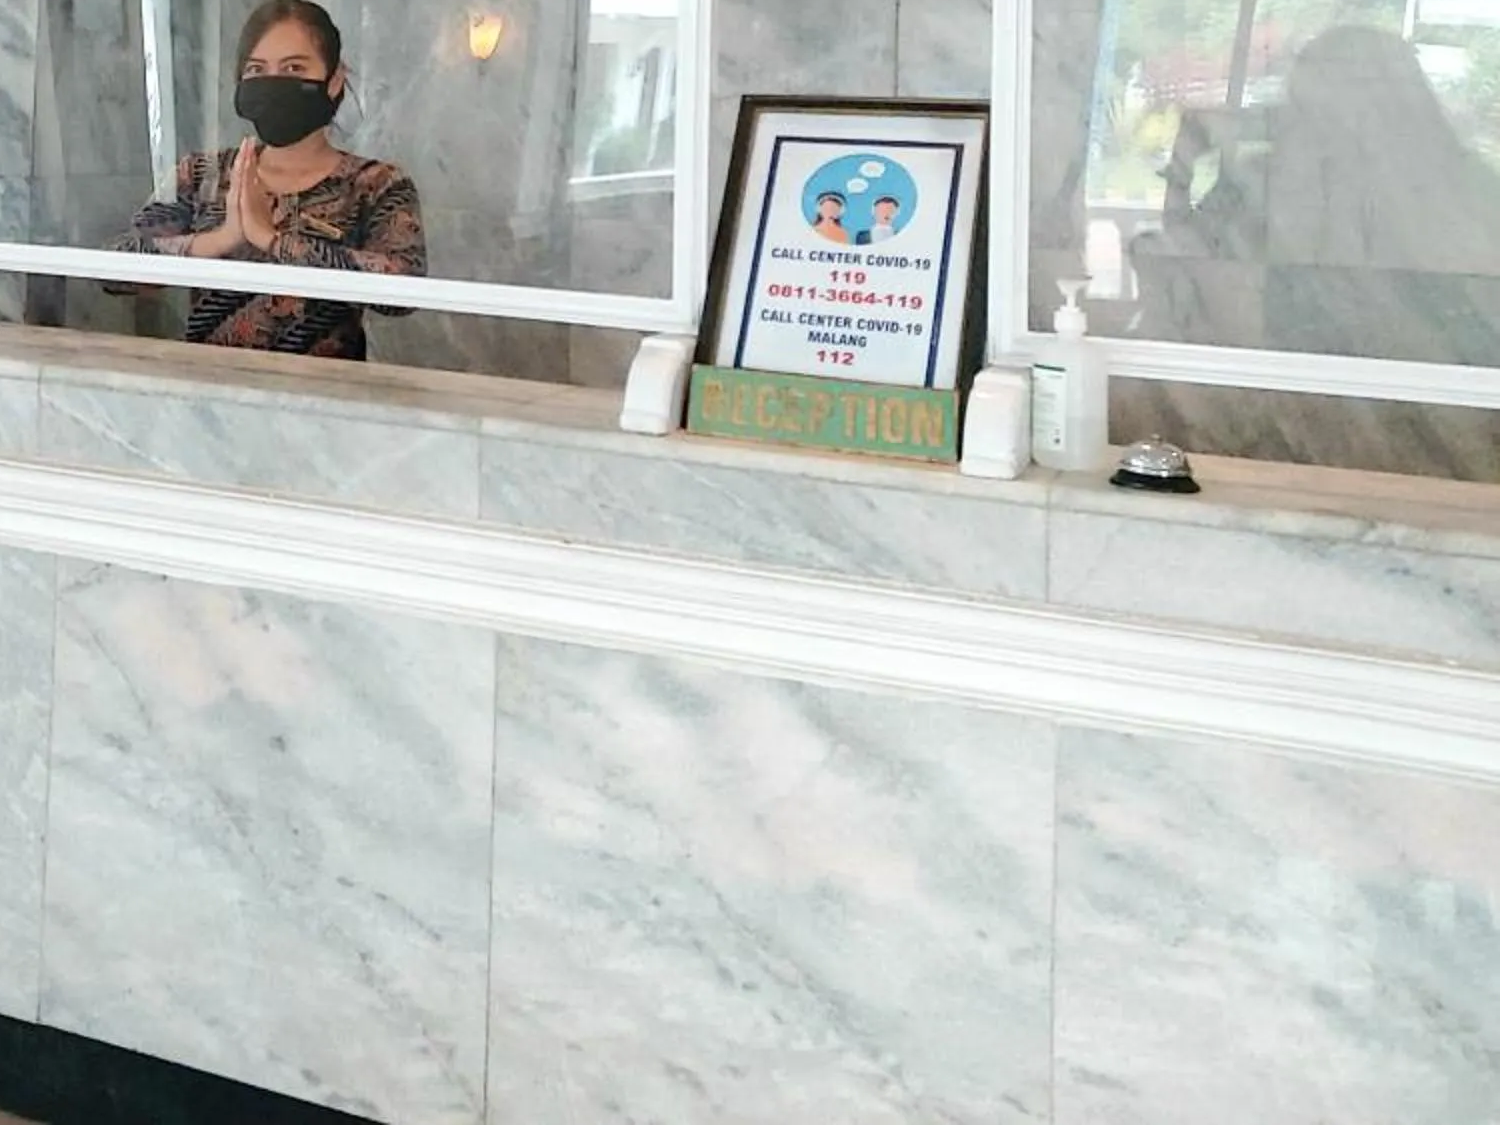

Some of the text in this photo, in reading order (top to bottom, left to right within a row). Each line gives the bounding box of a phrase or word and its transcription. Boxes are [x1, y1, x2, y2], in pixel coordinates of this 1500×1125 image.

[771, 248, 931, 270] CALL CENTER COVID-19
[829, 270, 867, 284] 119
[768, 284, 923, 310] 0811-3664-119
[761, 309, 923, 336] CALL CENTER COVID-19
[807, 331, 867, 348] MALANG
[816, 350, 855, 365] 112
[703, 379, 944, 446] RECEPTION
